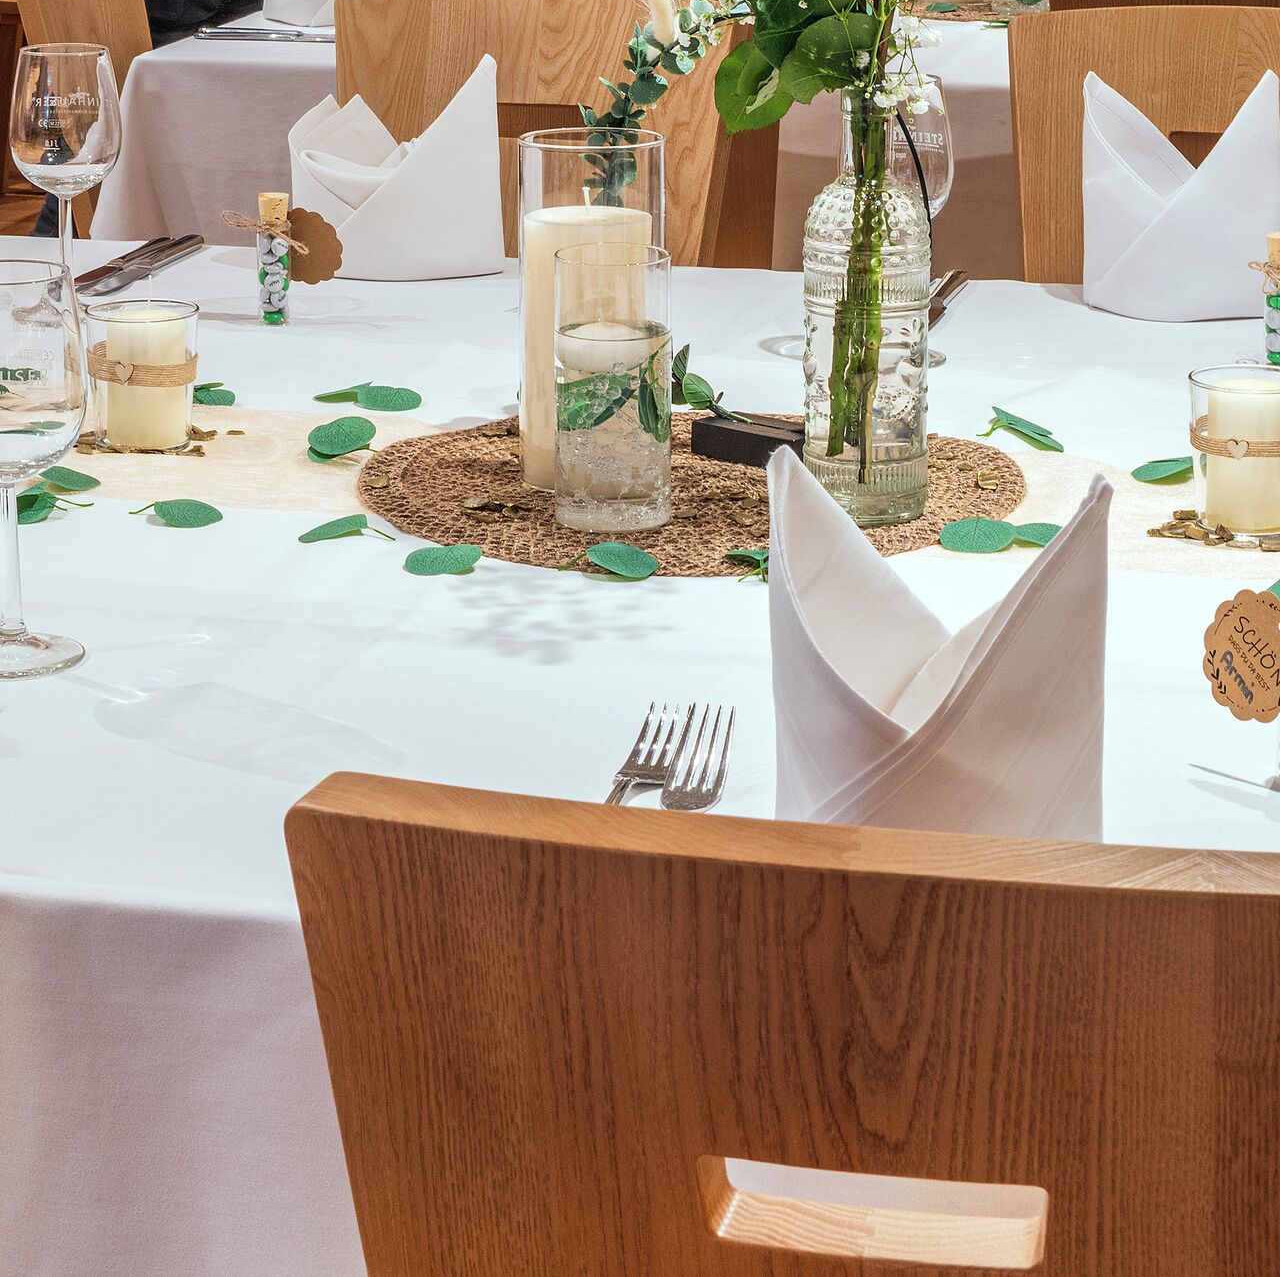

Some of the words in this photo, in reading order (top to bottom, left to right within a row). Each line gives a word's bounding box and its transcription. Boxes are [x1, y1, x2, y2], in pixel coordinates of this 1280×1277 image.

[1228, 634, 1243, 654] DASS
[1240, 652, 1249, 665] DU
[1248, 664, 1257, 675] DA
[1255, 673, 1271, 692] BIST
